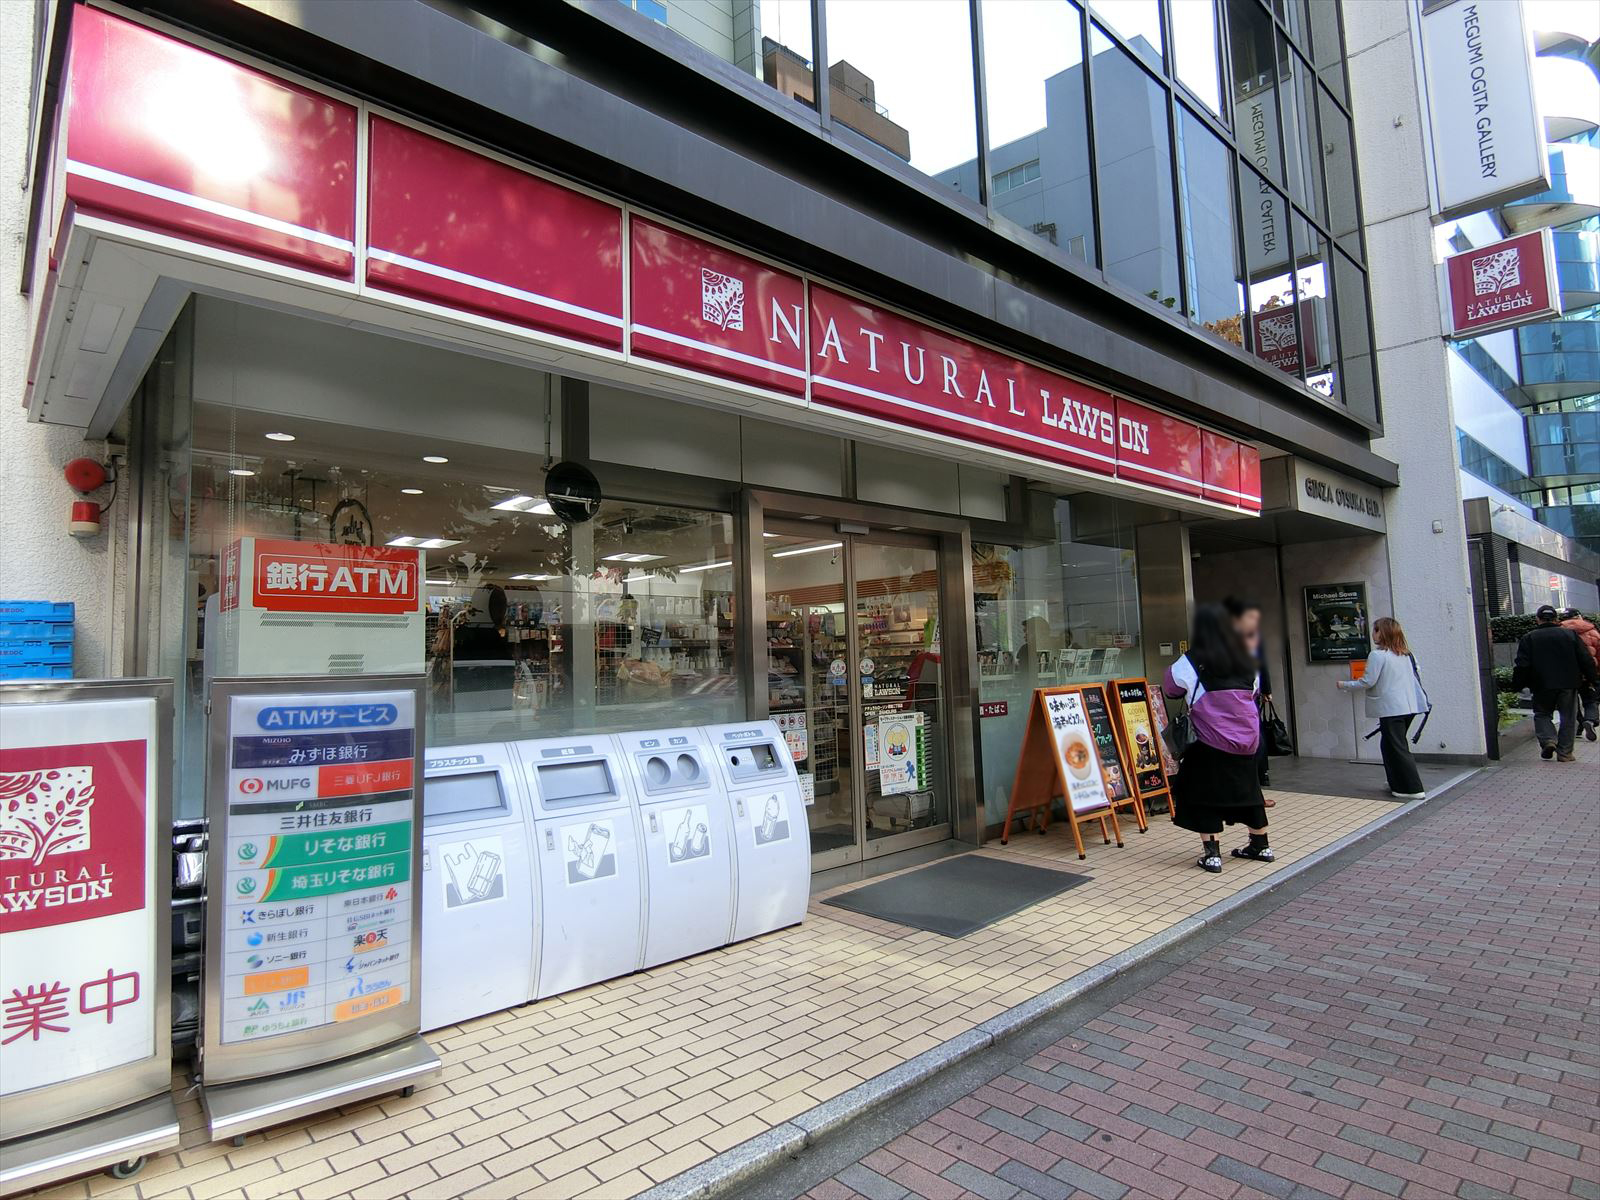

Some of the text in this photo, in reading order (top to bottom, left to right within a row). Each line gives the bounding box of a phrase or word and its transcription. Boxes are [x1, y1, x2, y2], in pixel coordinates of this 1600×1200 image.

[1463, 4, 1497, 179] MEGUMI OGITA GALLERY
[1467, 290, 1532, 311] NATURAL
[1467, 296, 1533, 321] LAWSON
[768, 296, 1026, 417] NATURAL
[1040, 389, 1149, 455] LAWSON
[1304, 477, 1334, 504] GINZA
[1335, 487, 1365, 513] OTSUKA
[266, 561, 408, 595] 銀行ATM
[1312, 592, 1337, 600] Michael
[874, 687, 901, 696] LAWSON
[266, 706, 391, 726] ATMサービス
[288, 744, 369, 764] みずほ銀行
[430, 756, 478, 768] プラスチック類
[266, 778, 311, 791] MUFG
[334, 770, 401, 786] 三菱UFJ銀行
[280, 808, 373, 830] 三井住友銀行
[304, 832, 387, 856] りそな銀行
[291, 863, 395, 890] 埼玉りそな銀行
[258, 904, 315, 920] きらぼし銀行
[266, 928, 309, 942] 新生銀行
[266, 950, 307, 964] ソニー銀行
[1, 968, 140, 1045] 業中
